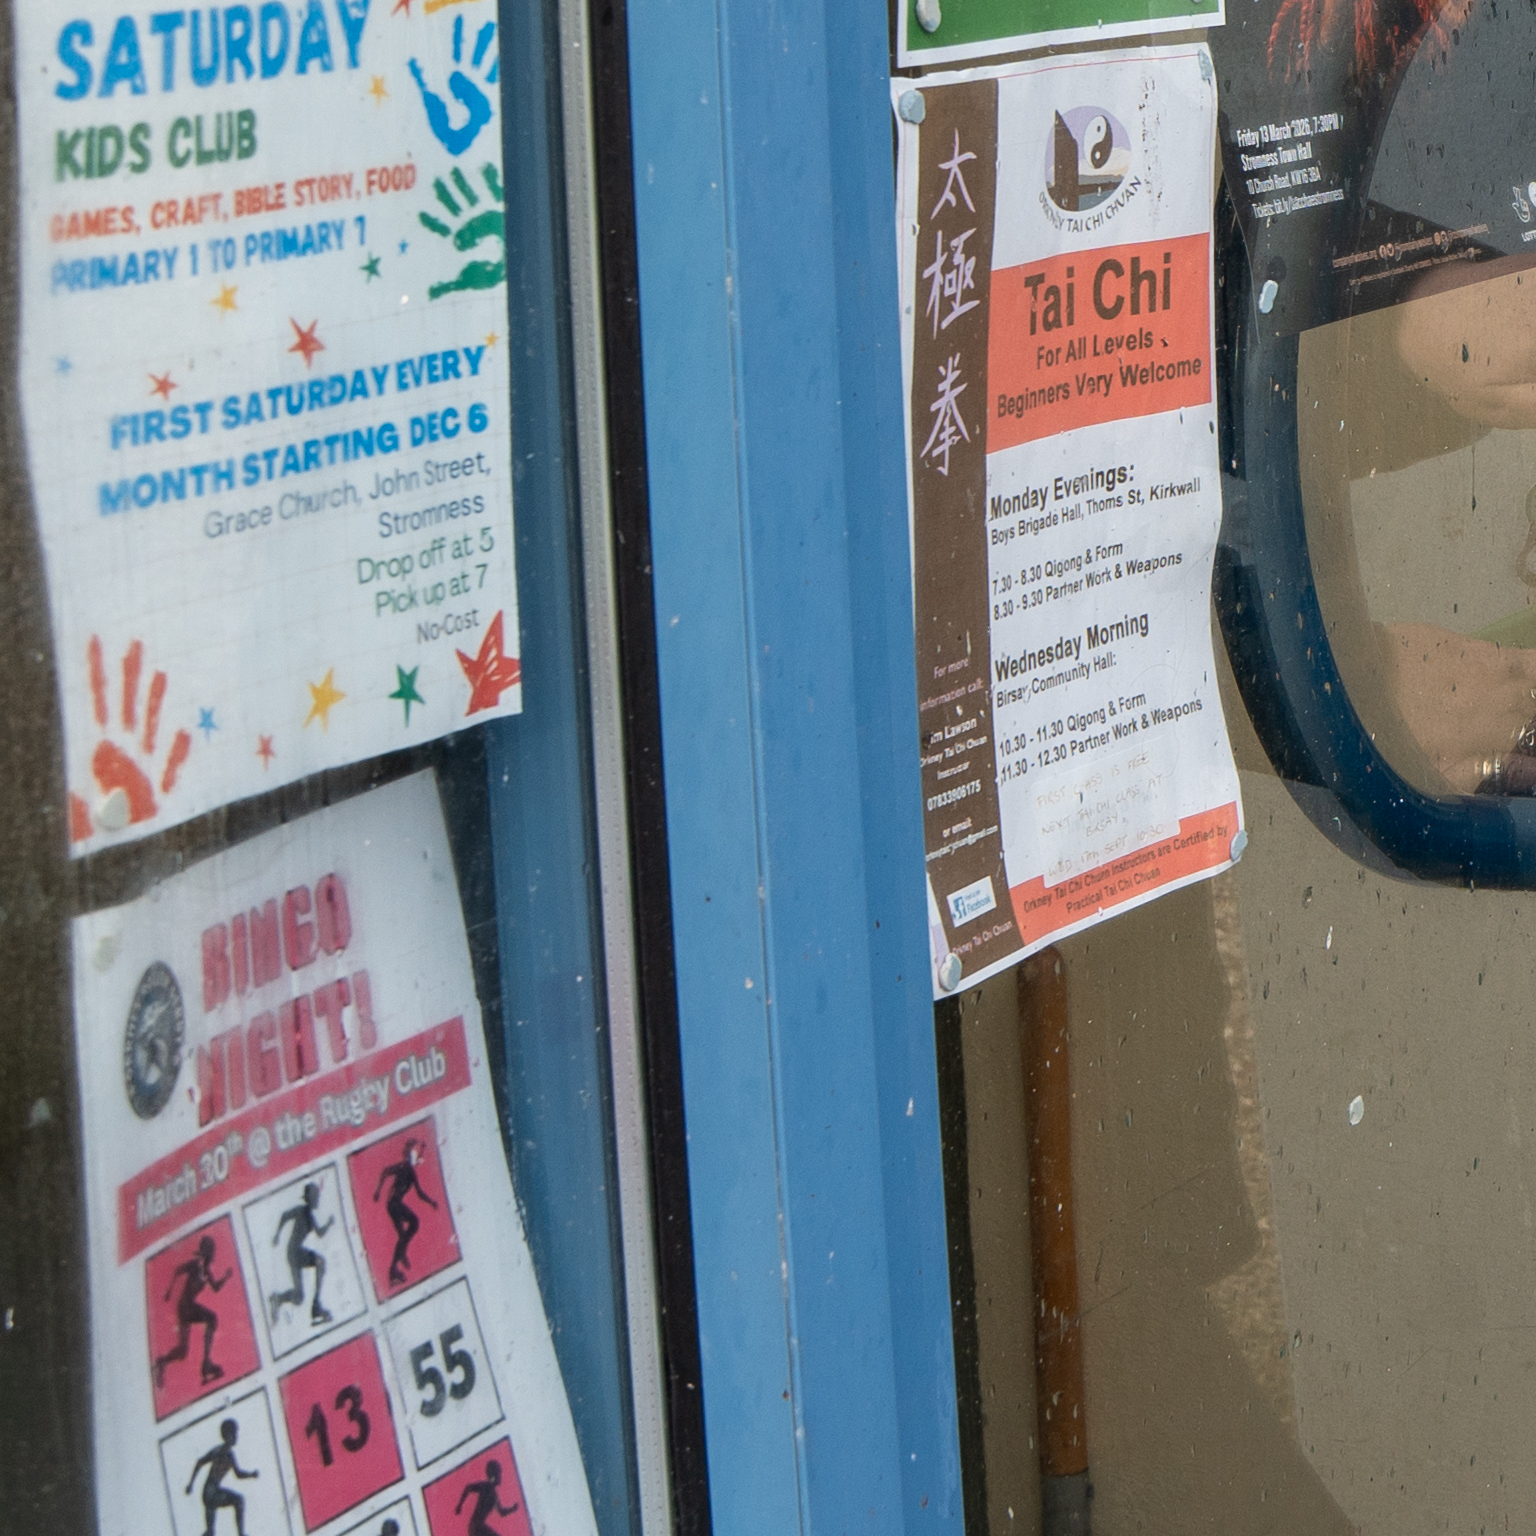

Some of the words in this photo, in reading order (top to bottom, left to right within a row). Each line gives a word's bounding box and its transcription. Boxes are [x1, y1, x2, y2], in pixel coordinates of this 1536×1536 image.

[55, 121, 152, 183] KIDS
[168, 108, 257, 169] CLUB
[1236, 129, 1259, 148] Friday
[1260, 127, 1269, 142] 13
[1269, 122, 1292, 142] March
[1312, 113, 1339, 133] 7:30PM
[1241, 152, 1278, 171] Stromness
[1278, 147, 1297, 164] Town
[1298, 141, 1312, 160] Hall
[49, 205, 141, 243] GAMES,
[151, 193, 229, 231] CRAFT,
[235, 181, 286, 218] BIBLE
[294, 172, 361, 210] STORY,
[366, 162, 417, 196] FOOD
[1067, 219, 1083, 232] TAI
[1085, 212, 1103, 231] CHI
[1106, 176, 1142, 219] CHUAN
[50, 248, 179, 296] PRIMARY
[190, 245, 197, 275] 1
[208, 239, 236, 272] TO
[245, 221, 346, 264] PRIMARY
[921, 128, 980, 476] 太極拳
[1024, 266, 1075, 336] Tai
[1093, 252, 1171, 320] Chi
[1037, 345, 1061, 370] For
[1065, 337, 1086, 364] All
[1093, 328, 1153, 357] Levels
[111, 402, 214, 451] FIRST
[221, 365, 389, 430] SATURDAY
[397, 345, 486, 392] EVERY
[998, 383, 1070, 418] Beginners
[1076, 372, 1112, 397] Very
[1120, 357, 1202, 386] Welcome
[98, 460, 235, 517] MONTH
[242, 423, 399, 492] STARTING
[410, 407, 461, 447] DEC
[468, 402, 489, 433] 6
[991, 486, 1048, 519] Monday
[1054, 465, 1134, 501] Evenings:
[204, 506, 273, 539] Grace
[278, 480, 363, 521] Church,
[368, 467, 420, 501] John
[423, 451, 492, 487] Street,
[378, 494, 484, 538] Stromness
[991, 527, 1015, 546] Boys
[1018, 512, 1058, 536] Brigade
[1061, 507, 1084, 524] Hall,
[1086, 494, 1123, 515] Thoms
[1128, 489, 1145, 505] St,
[1150, 478, 1200, 501] Kirkwall
[357, 555, 414, 586] Drop
[418, 537, 446, 572] off
[451, 535, 474, 560] at
[480, 527, 494, 553] 5
[993, 575, 1012, 596] 7.30
[1021, 565, 1042, 586] 8.30
[1045, 555, 1081, 578] Qigong
[1085, 548, 1092, 565] &
[1095, 542, 1123, 561] Form
[994, 600, 1013, 621] 8.30
[1022, 589, 1043, 611] 9.30
[1046, 580, 1083, 602] Partner
[1086, 569, 1111, 589] Work
[1115, 563, 1122, 579] &
[1126, 552, 1182, 575] Weapons
[376, 589, 418, 618] Pick
[423, 580, 446, 607] up
[449, 572, 470, 596] at
[475, 565, 488, 590] 7
[416, 608, 480, 645] No-Cost
[995, 634, 1081, 682] Wednesday
[1086, 613, 1149, 650] Morning
[997, 684, 1031, 708] Birsay
[1031, 664, 1091, 694] Community
[1093, 652, 1117, 673] Hall:
[1000, 733, 1026, 757] 10.30
[1036, 720, 1063, 746] 11.30
[1067, 707, 1106, 731] Qigong
[1108, 700, 1117, 715] &
[1119, 693, 1146, 711] Form
[1001, 758, 1028, 783] 11.30
[1040, 744, 1067, 768] 12.30
[1070, 730, 1110, 756] Partner
[1113, 718, 1138, 738] Work
[1141, 712, 1149, 727] &
[1151, 699, 1203, 724] Weapons
[202, 872, 352, 1012] BINGO
[197, 968, 378, 1128] NIGHT!
[135, 1166, 196, 1231] March
[200, 1135, 243, 1190] 30th
[248, 1128, 272, 1167] @
[274, 1113, 316, 1153] the
[321, 1077, 391, 1129] Rugby
[395, 1046, 446, 1095] Club
[409, 1324, 477, 1417] 55
[305, 1384, 370, 1467] 13
